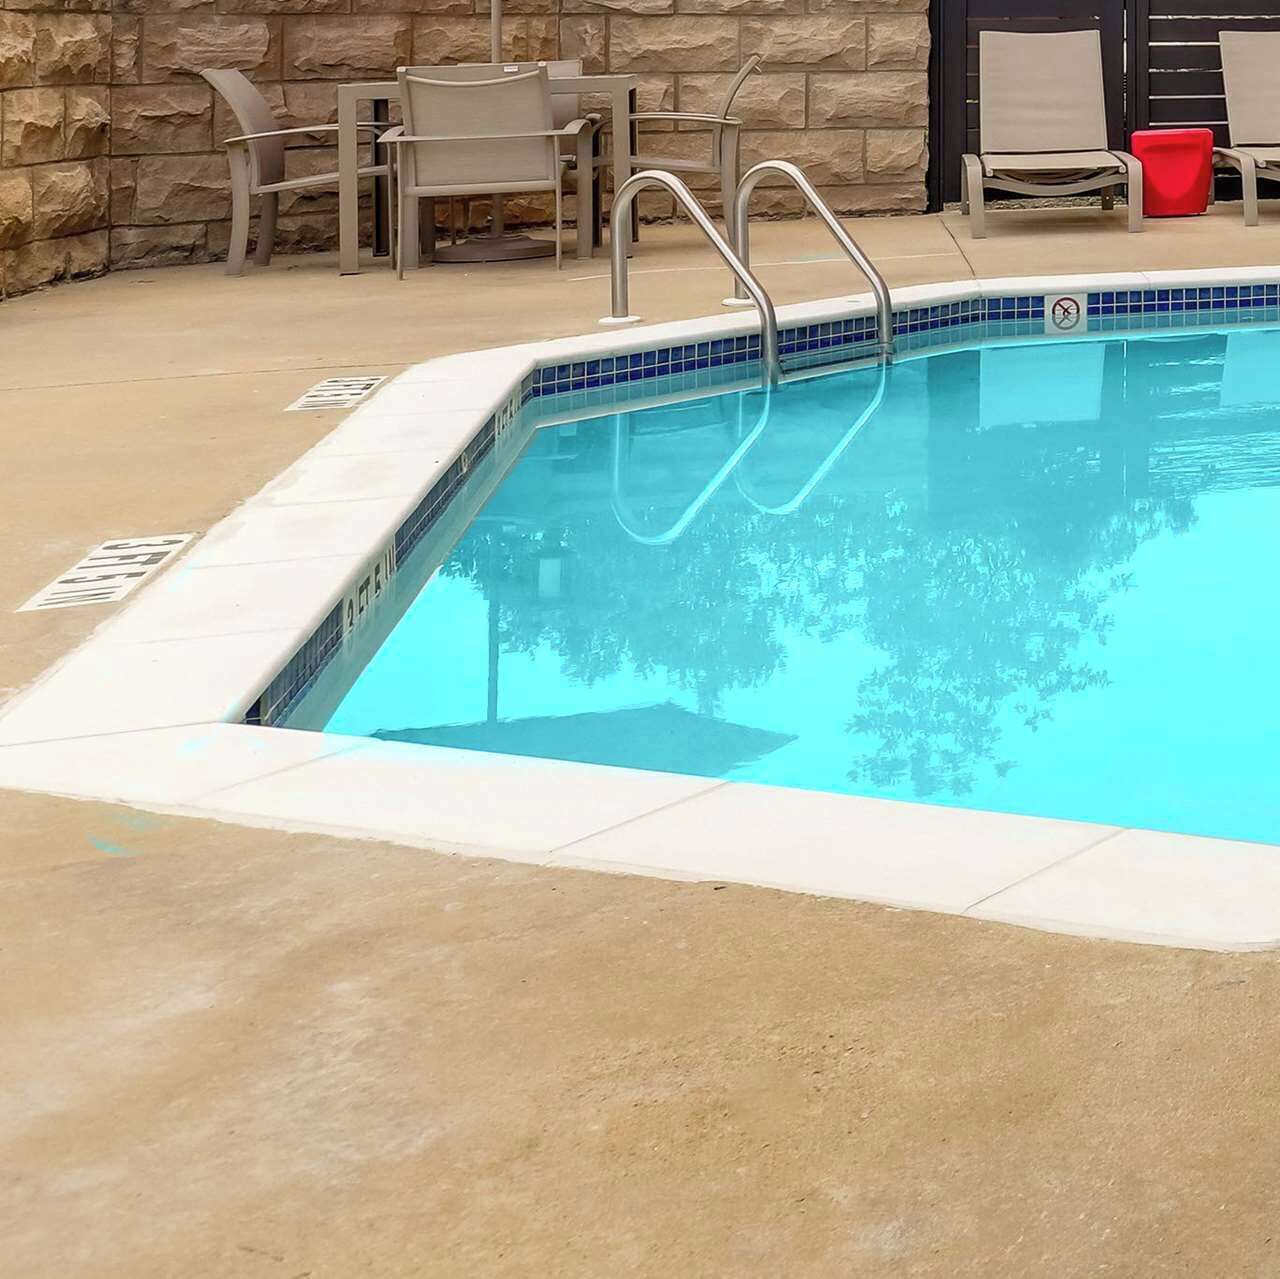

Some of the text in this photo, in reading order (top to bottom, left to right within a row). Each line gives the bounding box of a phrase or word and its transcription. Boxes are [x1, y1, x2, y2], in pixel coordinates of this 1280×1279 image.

[37, 539, 184, 608] 3 FT 5 IN
